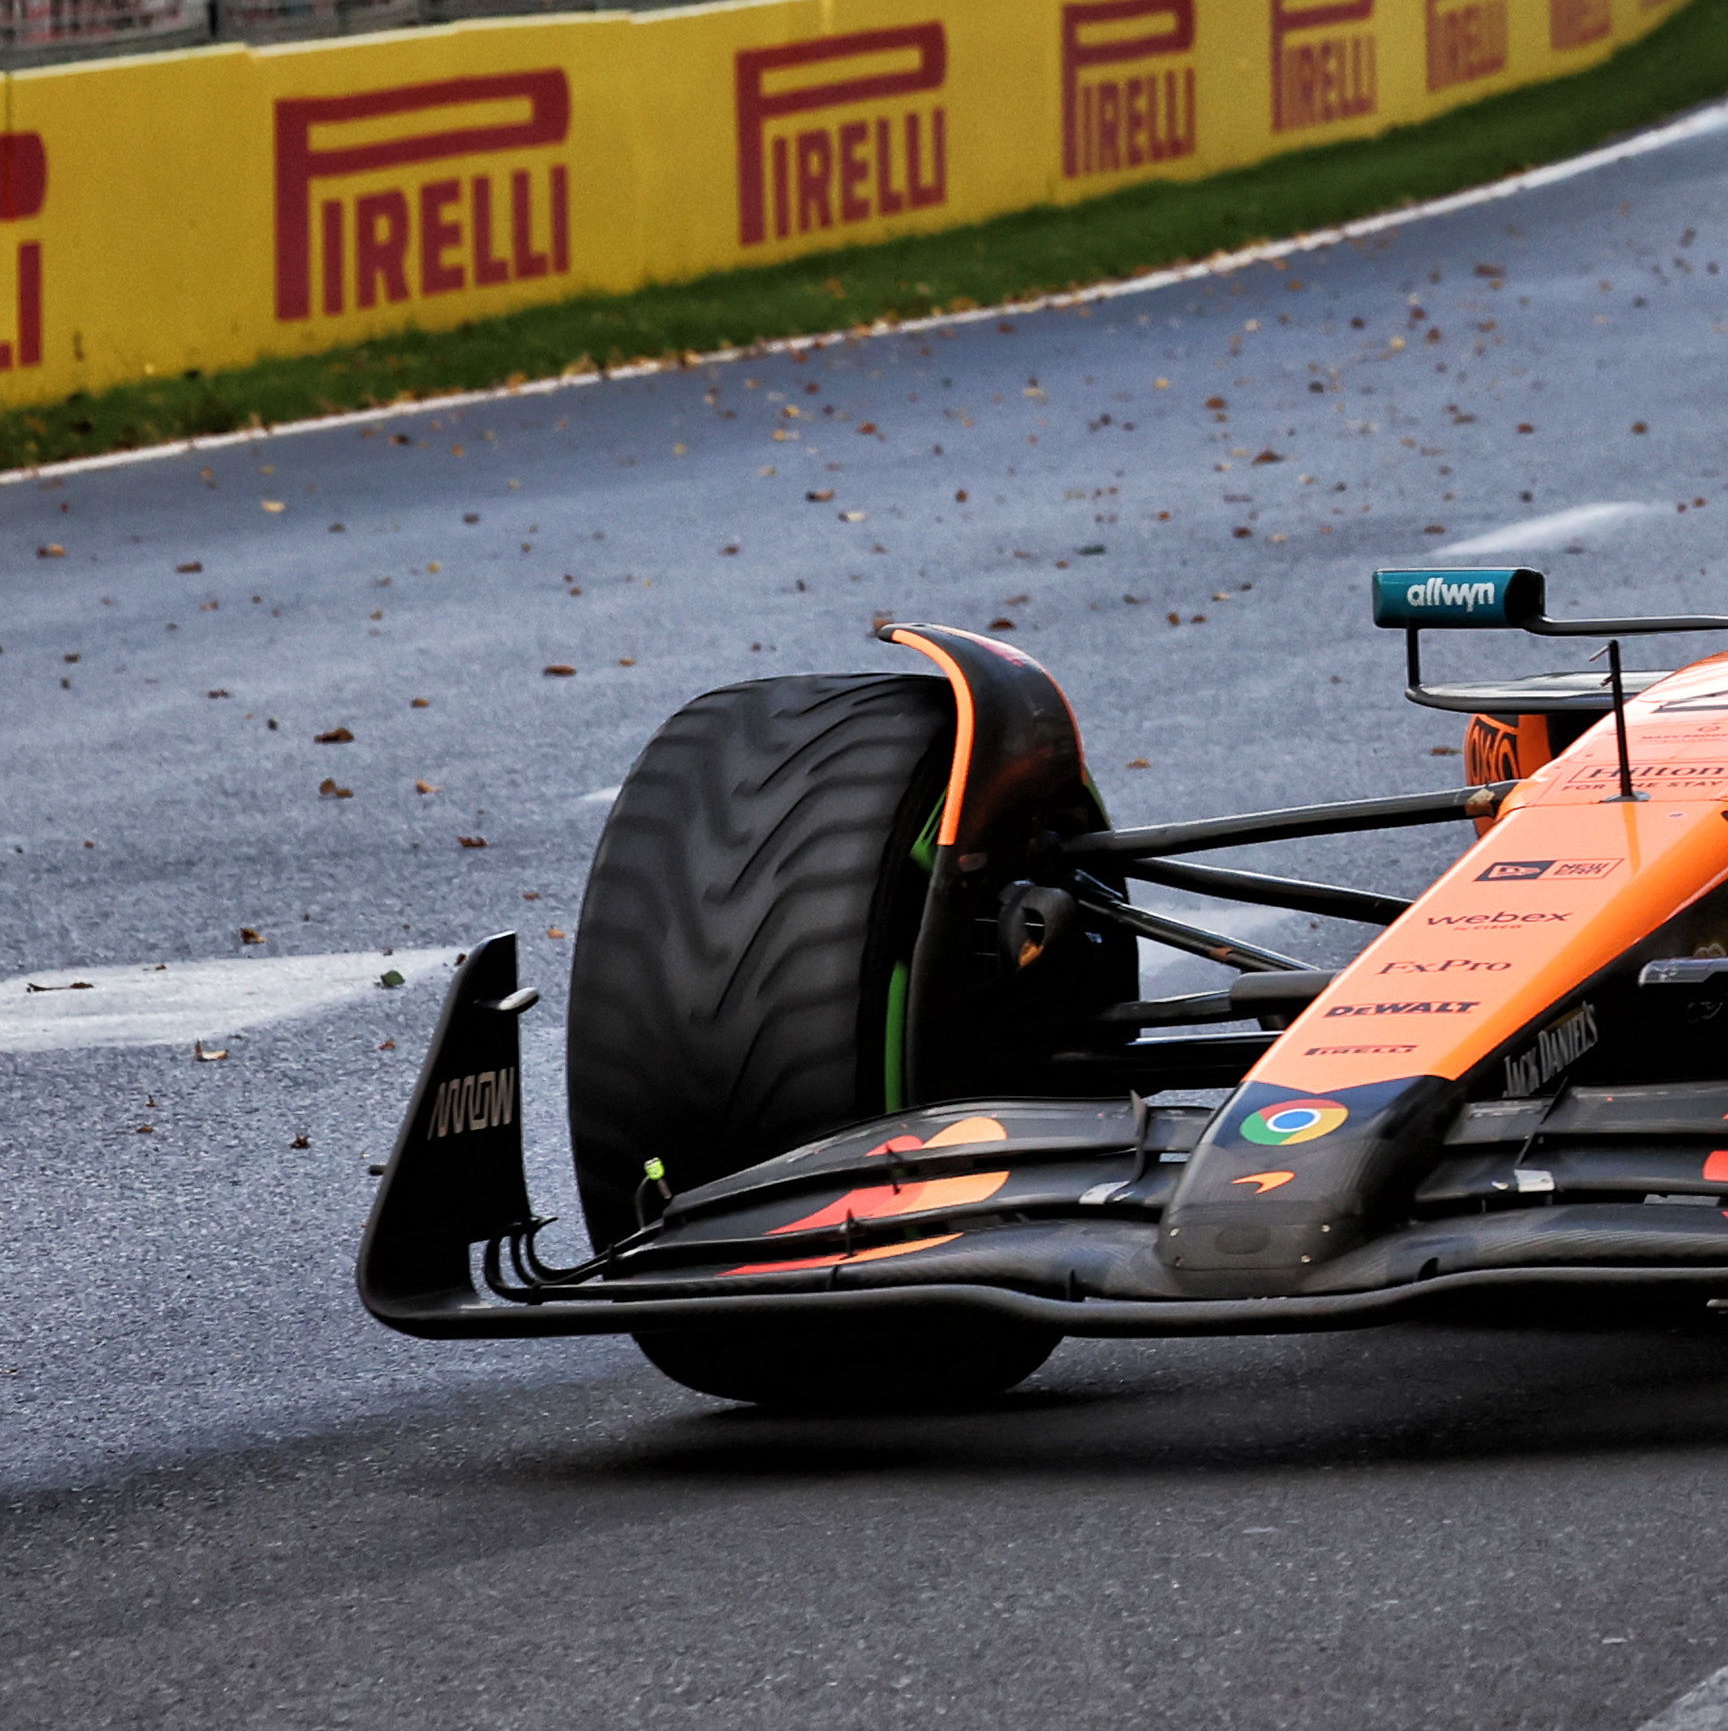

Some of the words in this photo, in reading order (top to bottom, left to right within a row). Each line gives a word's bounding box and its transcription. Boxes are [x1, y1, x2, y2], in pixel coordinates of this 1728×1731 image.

[735, 22, 946, 247] PIRELLI
[274, 69, 571, 322] PIRELLI
[1406, 578, 1495, 612] allwyn
[1668, 780, 1723, 788] STAY
[1427, 911, 1574, 926] webex
[1375, 959, 1512, 975] FxPro
[1303, 1045, 1419, 1056] PIRELLI
